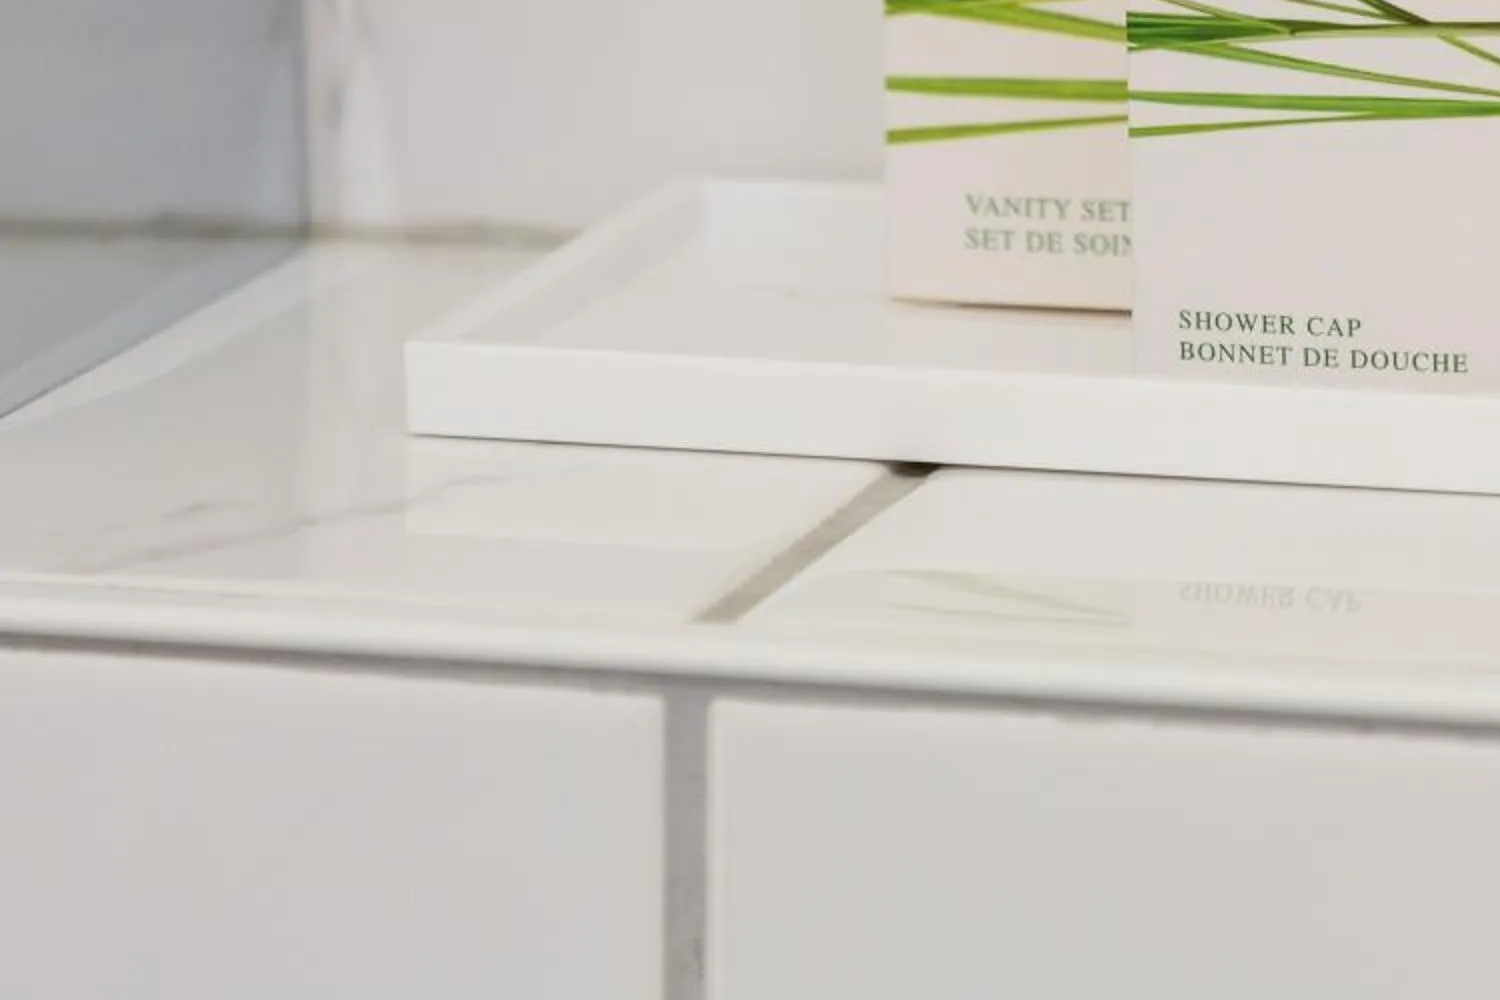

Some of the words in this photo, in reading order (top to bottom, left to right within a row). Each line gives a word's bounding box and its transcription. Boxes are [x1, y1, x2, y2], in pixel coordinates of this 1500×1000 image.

[964, 192, 1072, 221] VANITY
[1080, 198, 1132, 223] SET
[963, 227, 1017, 252] SET
[1024, 230, 1064, 254] DE
[1177, 308, 1297, 336] SHOWER
[1305, 315, 1364, 339] CAP
[1178, 340, 1294, 367] BONNET
[1302, 347, 1341, 370] DE
[1349, 349, 1470, 375] DOUCHE
